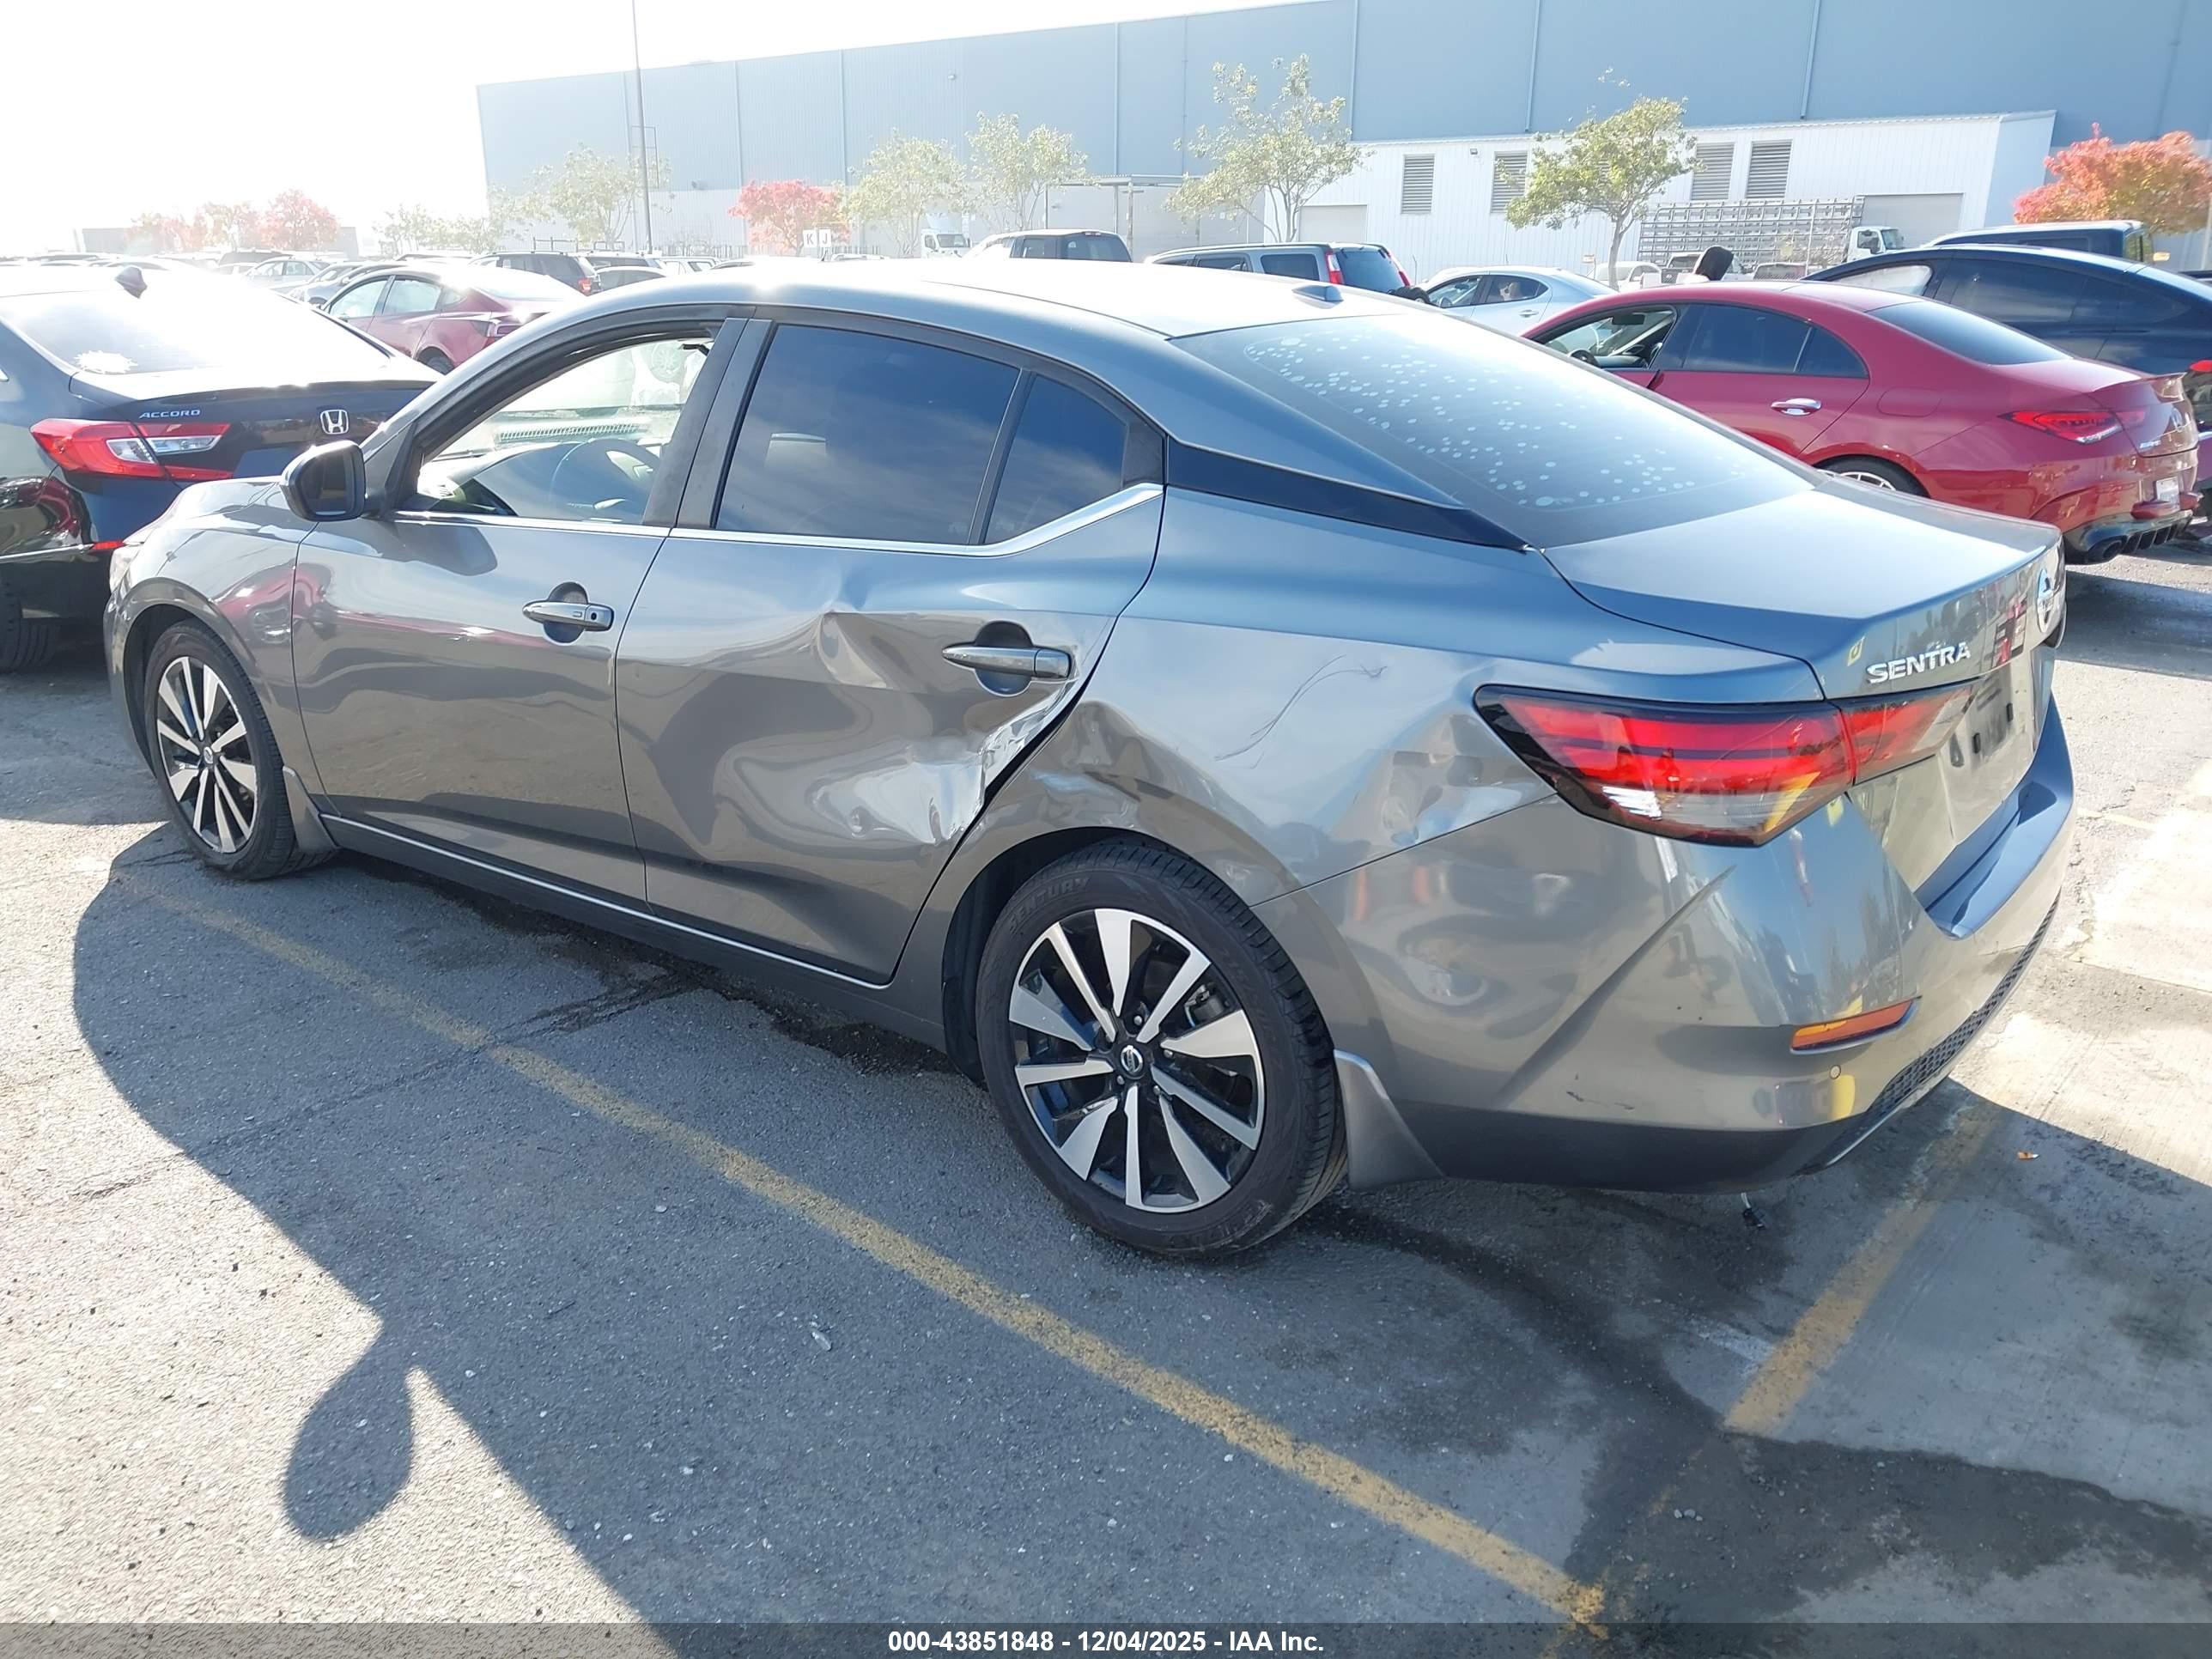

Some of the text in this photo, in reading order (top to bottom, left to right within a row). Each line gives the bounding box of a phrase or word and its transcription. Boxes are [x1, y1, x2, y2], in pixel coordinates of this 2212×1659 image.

[805, 233, 815, 246] K
[822, 233, 829, 246] J
[139, 408, 201, 420] ACCORD
[1866, 641, 1972, 684] SENTRA
